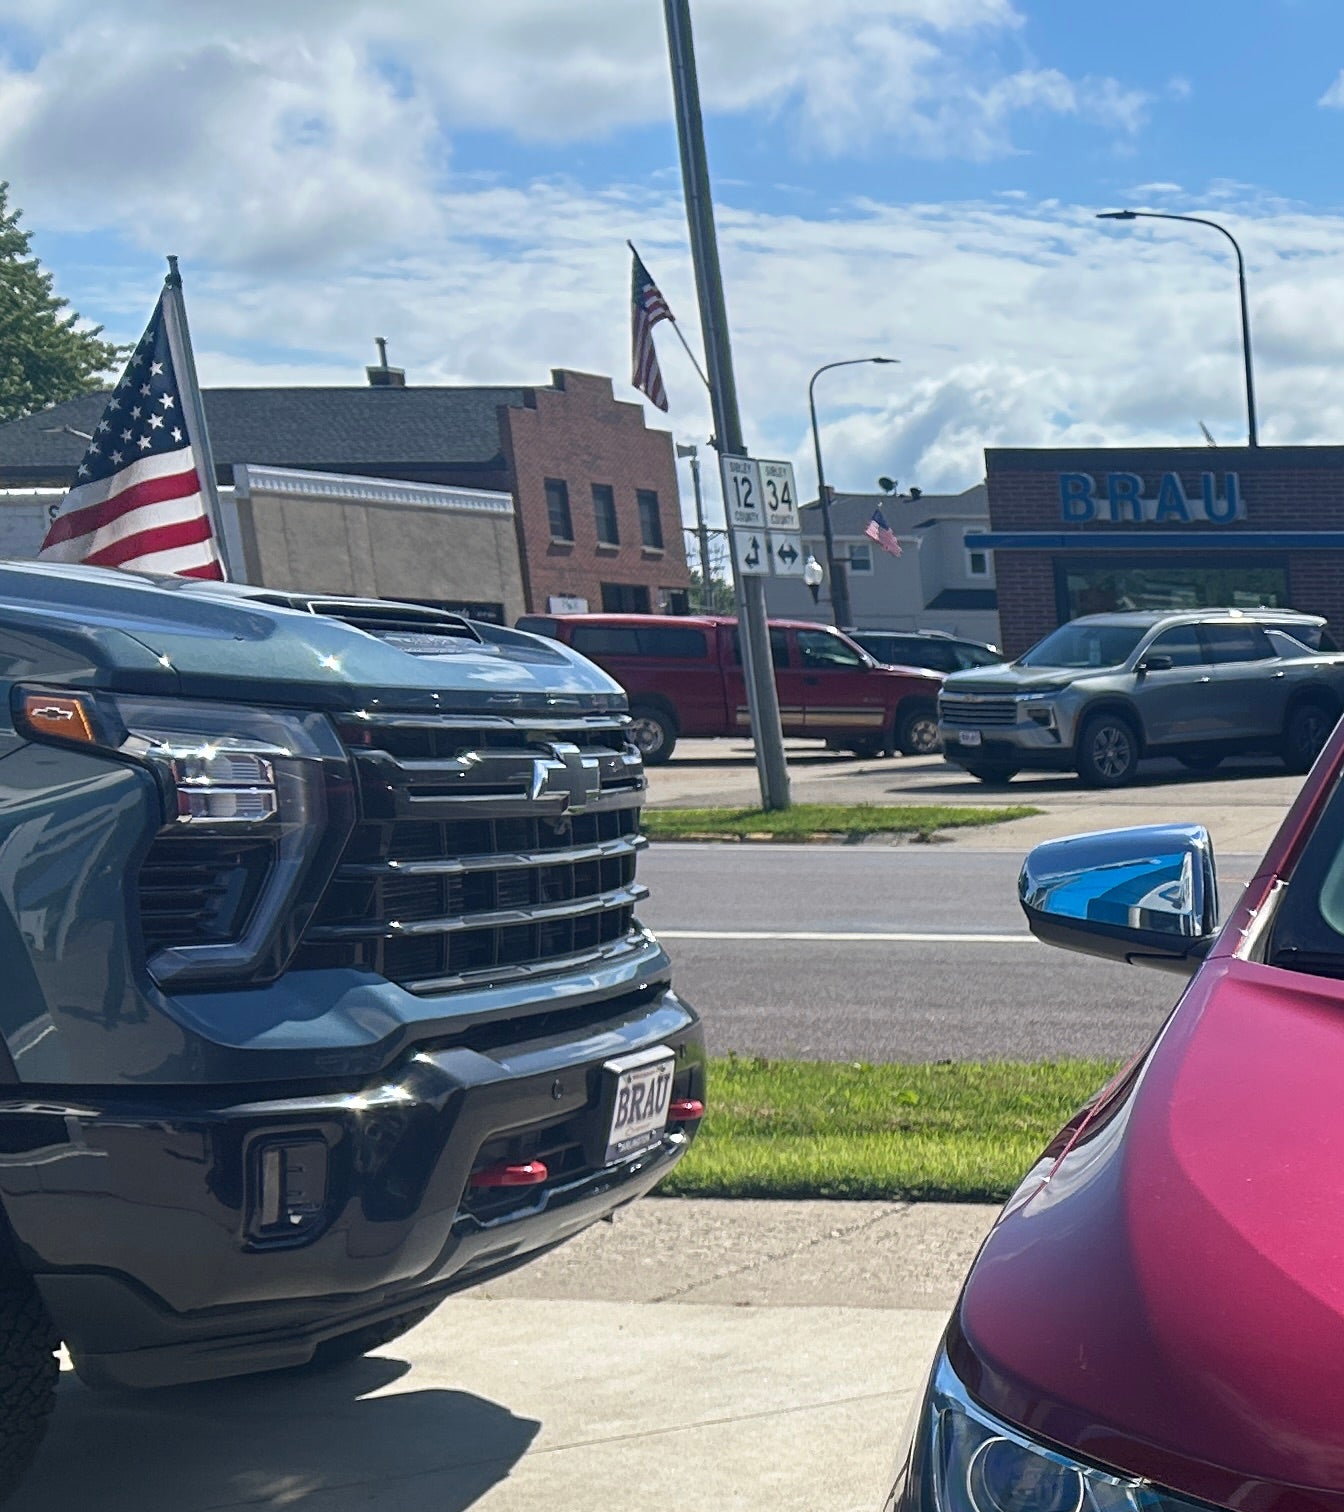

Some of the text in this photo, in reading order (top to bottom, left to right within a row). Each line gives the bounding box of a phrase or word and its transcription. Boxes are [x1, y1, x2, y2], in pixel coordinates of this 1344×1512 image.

[733, 476, 755, 508] 12
[766, 480, 793, 512] 34
[1060, 472, 1241, 524] BRAU
[614, 1073, 671, 1129] BRAU
